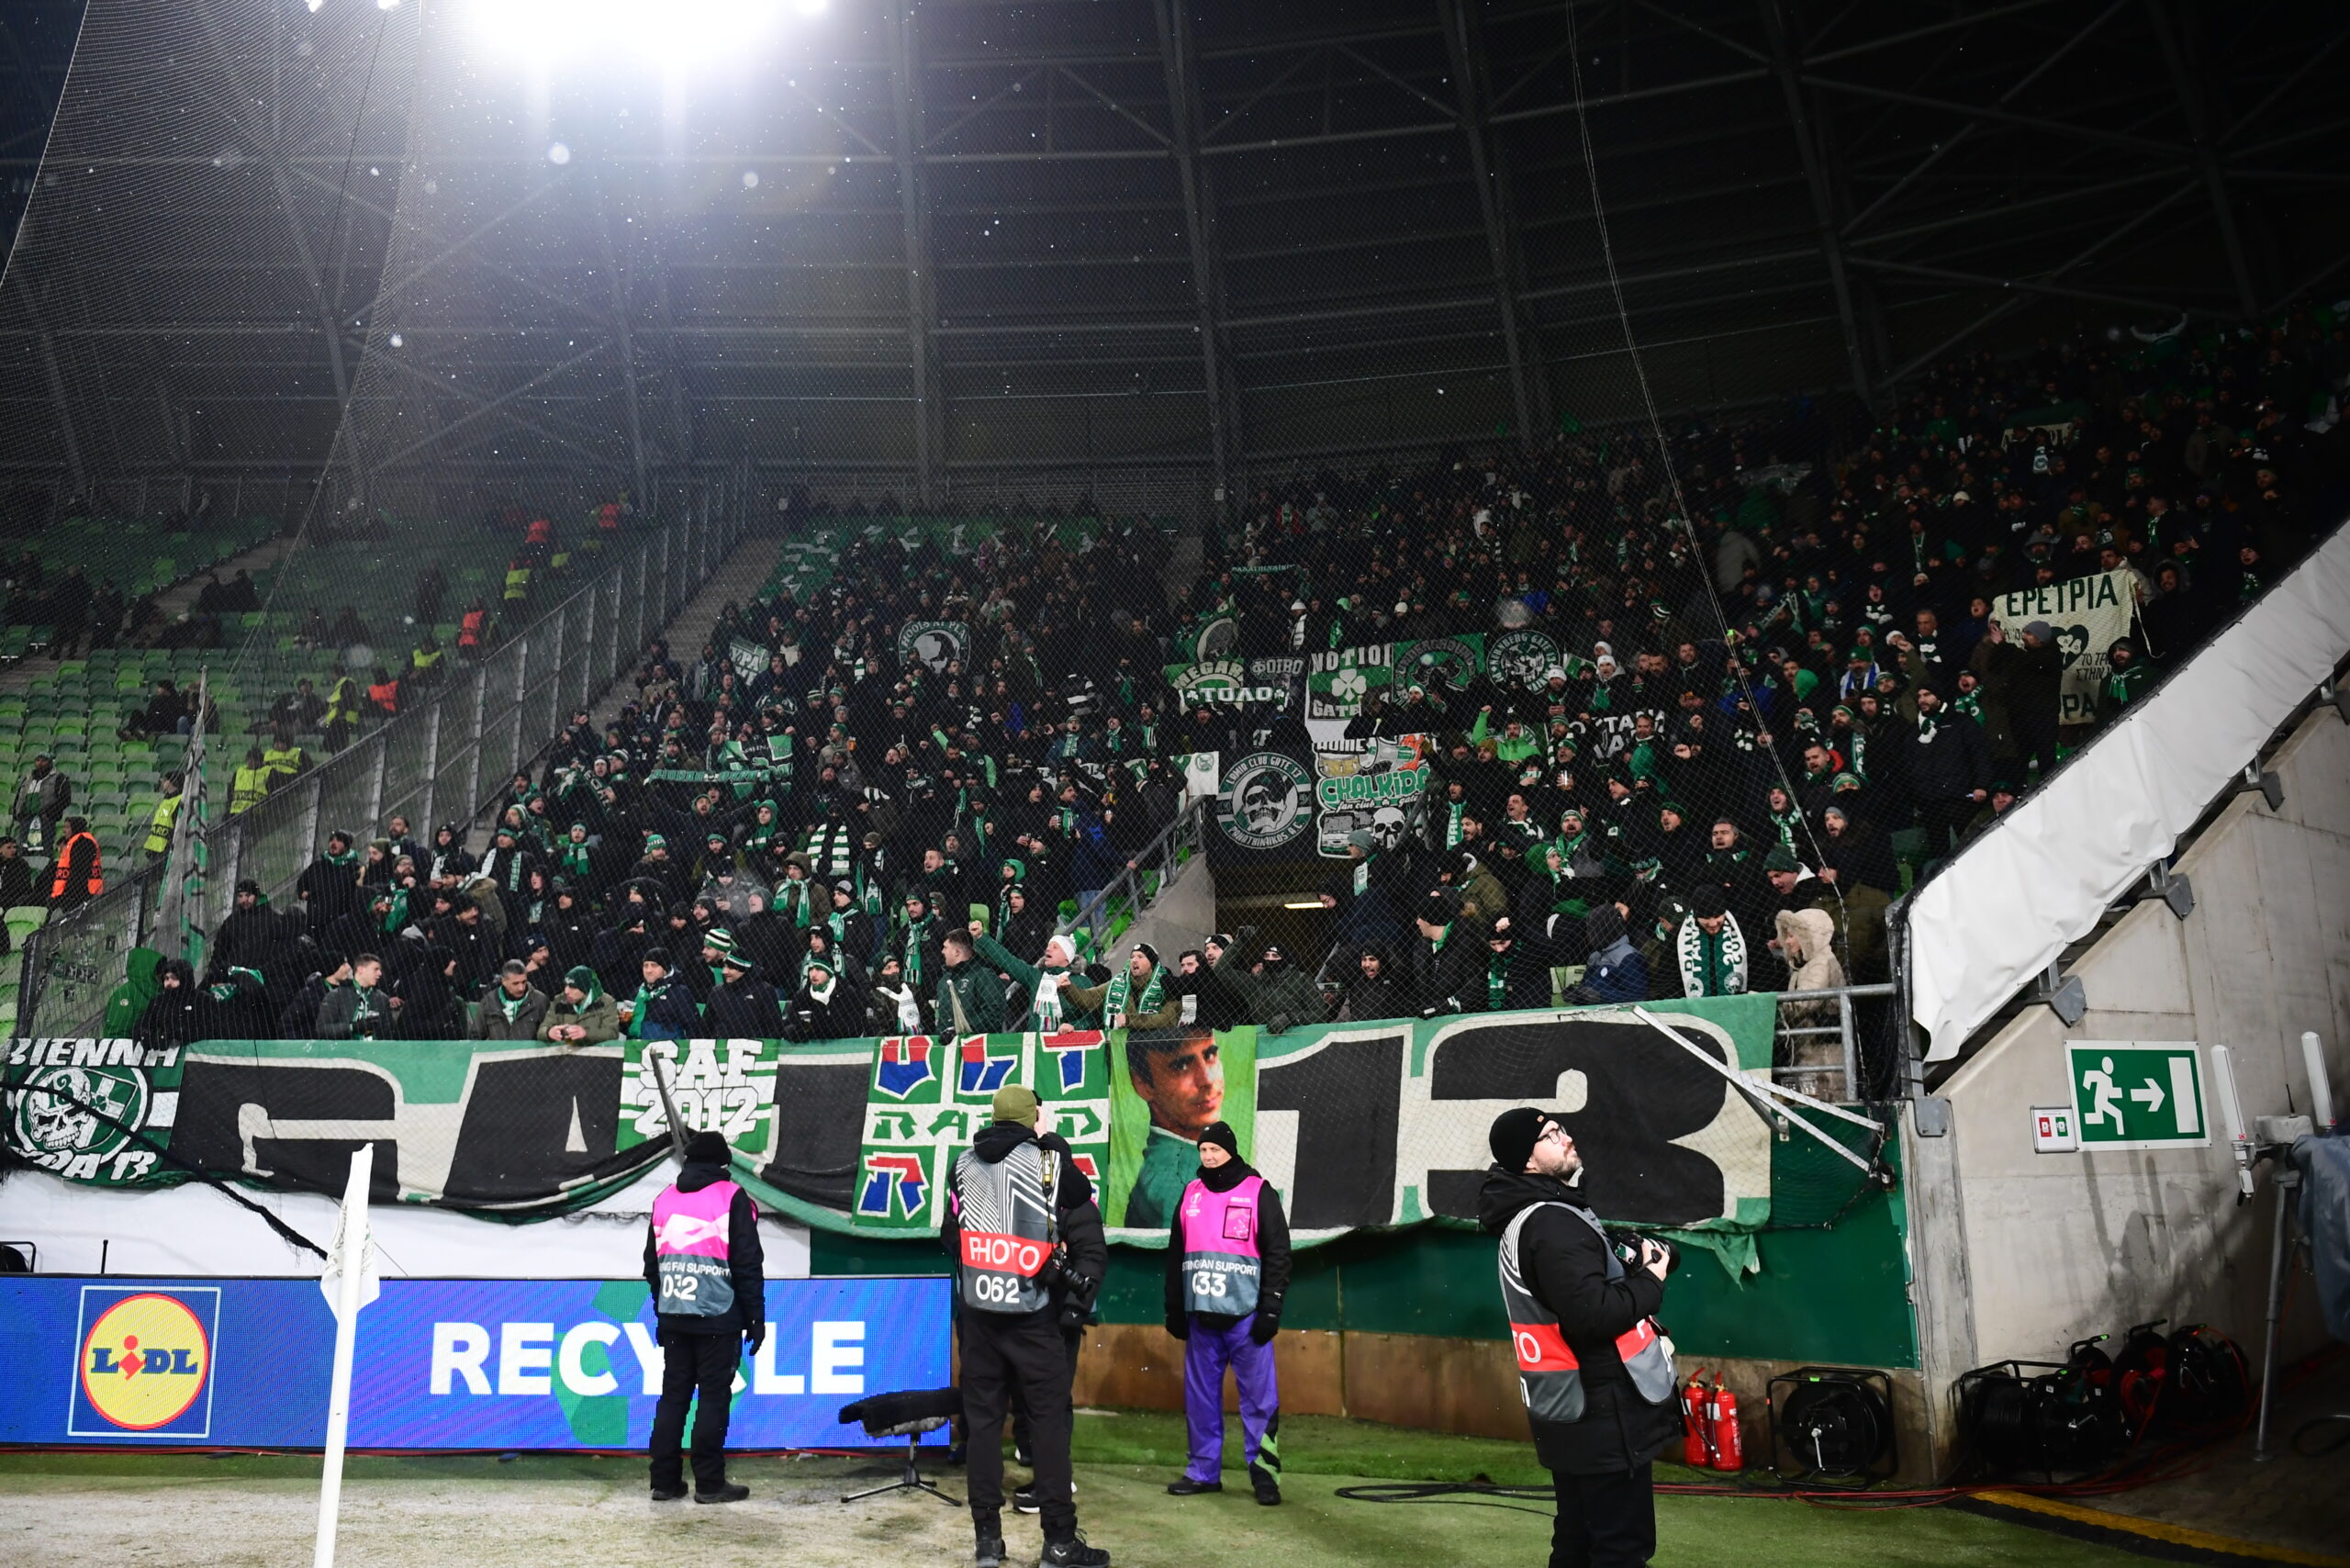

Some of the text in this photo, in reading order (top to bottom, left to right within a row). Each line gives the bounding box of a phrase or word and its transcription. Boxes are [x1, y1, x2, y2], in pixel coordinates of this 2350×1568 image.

[1248, 756, 1268, 767] CLUB
[1270, 756, 1292, 770] GATE
[1292, 767, 1303, 778] 13
[1355, 799, 1375, 810] club
[634, 1086, 758, 1134] 2012
[968, 1237, 1040, 1271] PHOTO
[687, 1262, 731, 1277] SUPPORT
[1215, 1260, 1258, 1276] SUPPORT
[975, 1274, 1021, 1304] 062
[430, 1321, 866, 1396] RECYLE
